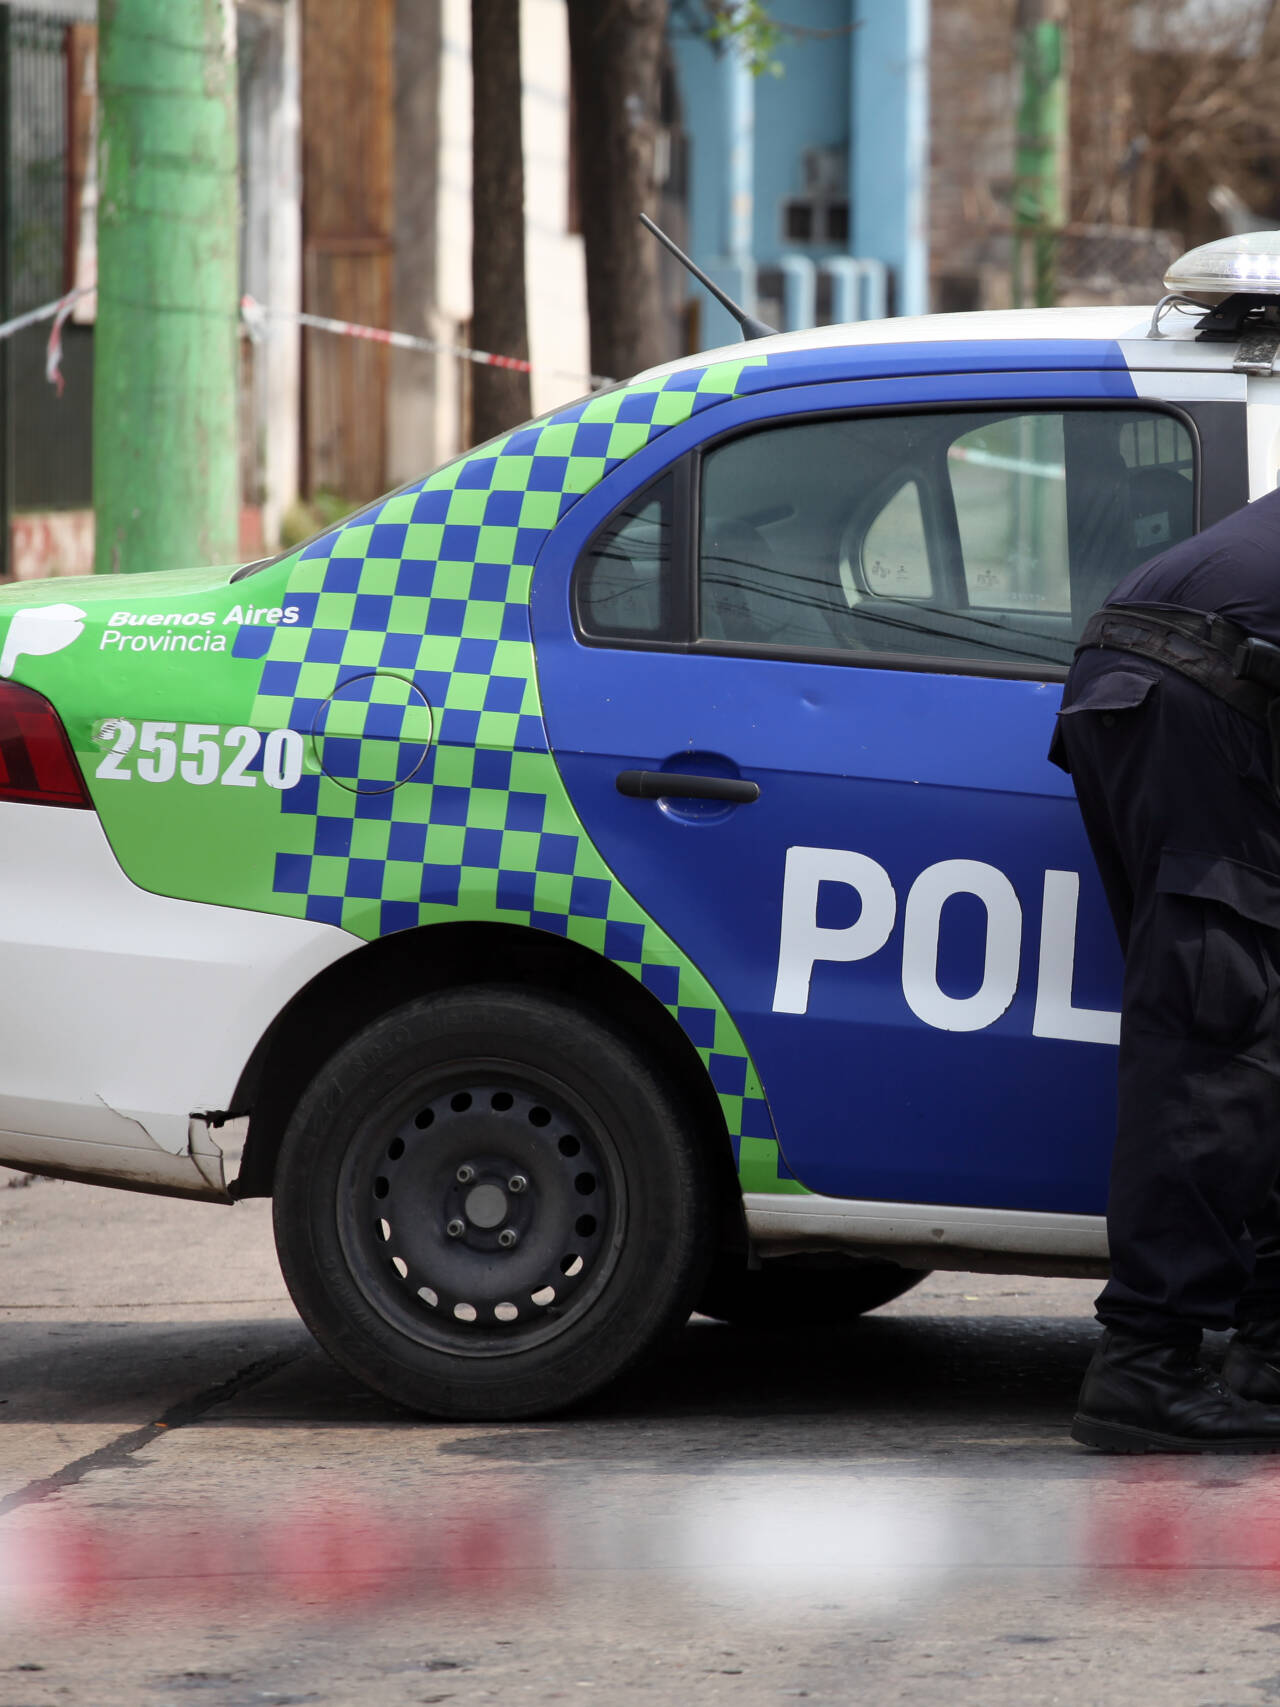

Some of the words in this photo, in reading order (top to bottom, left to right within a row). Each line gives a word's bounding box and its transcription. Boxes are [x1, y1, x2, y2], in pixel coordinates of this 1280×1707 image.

[107, 610, 217, 627] Buenos
[222, 604, 300, 626] Aires
[99, 629, 227, 652] Provincia
[95, 717, 304, 790] 25520
